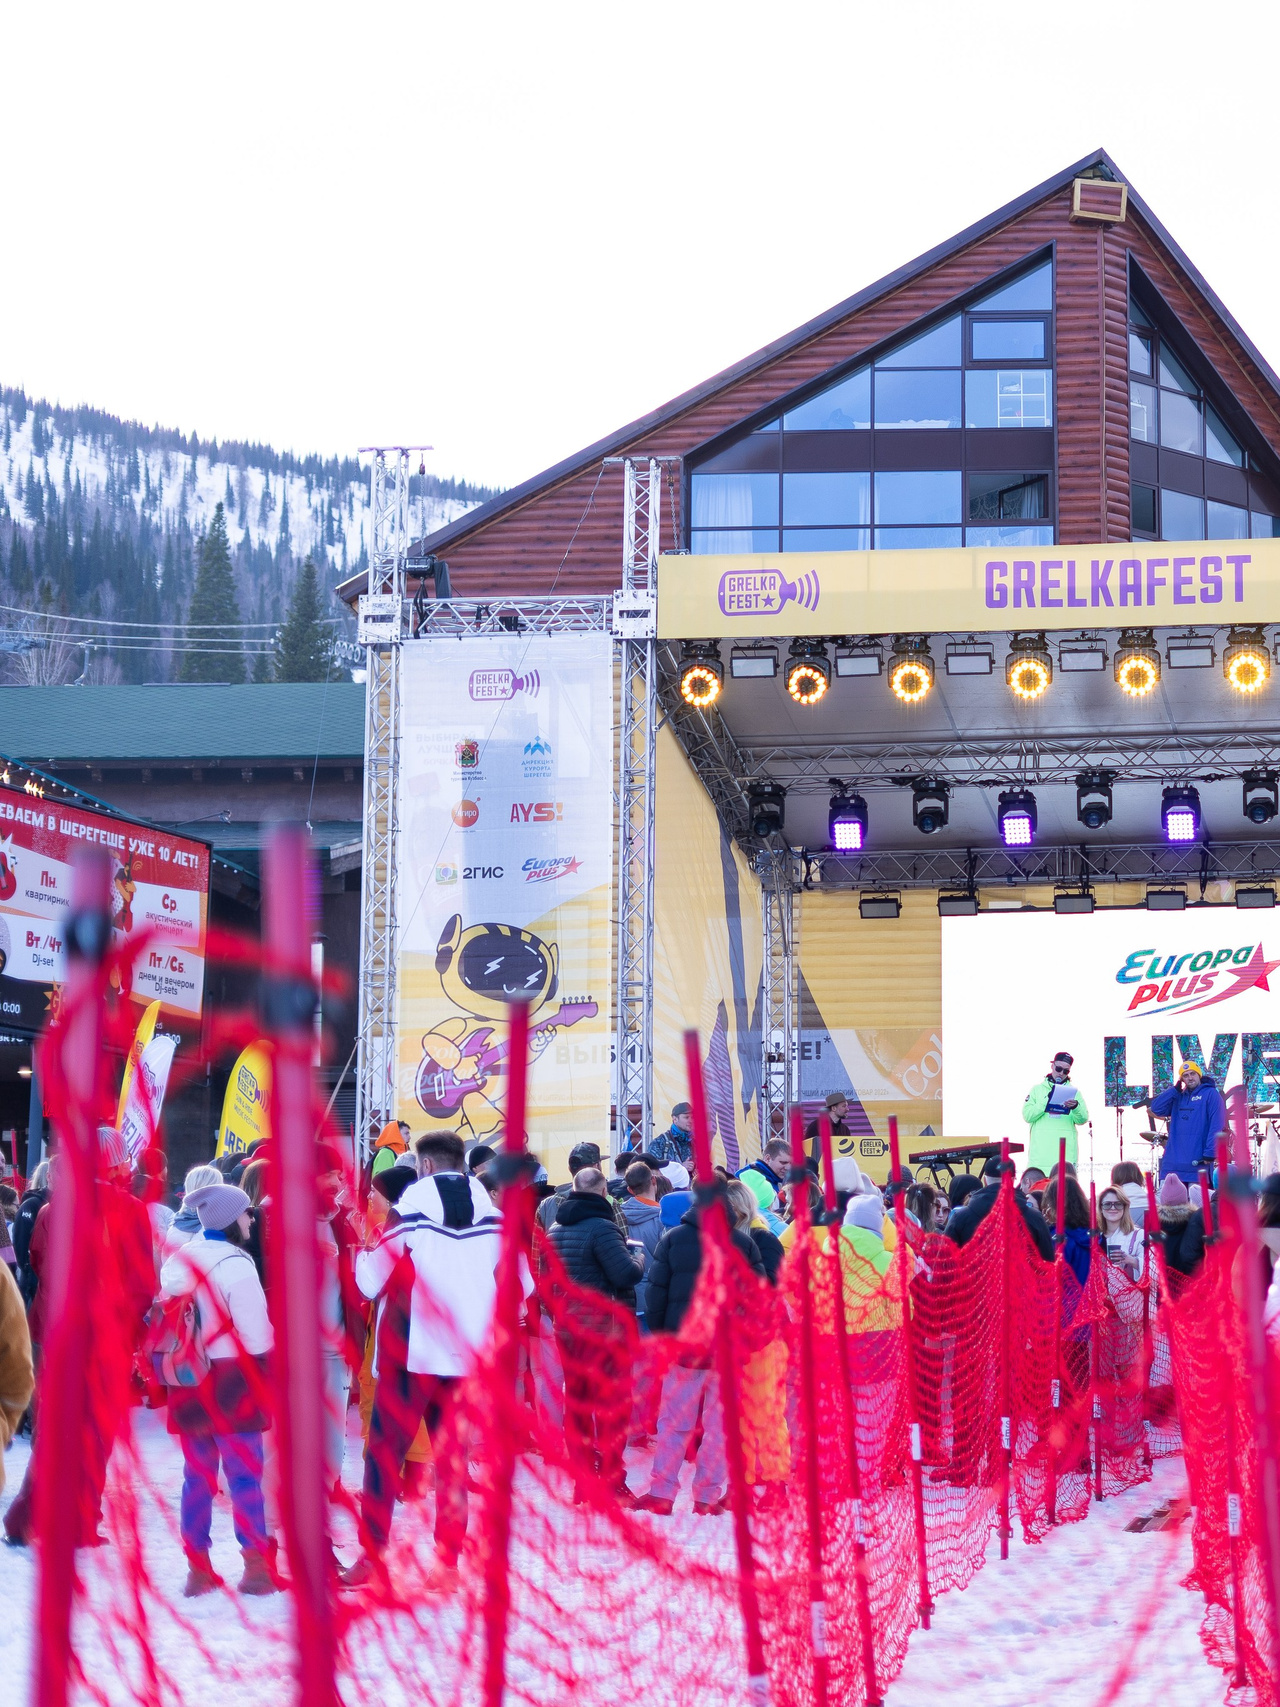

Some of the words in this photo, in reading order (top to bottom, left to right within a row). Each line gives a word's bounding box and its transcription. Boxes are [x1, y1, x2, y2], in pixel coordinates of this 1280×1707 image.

[728, 576, 776, 593] GRELKA
[985, 554, 1252, 609] GRELKAFEST
[728, 594, 761, 610] FEST
[475, 672, 510, 685] GRELKA
[475, 685, 499, 697] FEST
[510, 802, 563, 823] AYS!
[48, 816, 56, 831] В
[60, 819, 125, 850] ШЕРЕГЕШЕ
[129, 837, 155, 857] УЖЕ
[158, 846, 170, 863] 10
[173, 853, 199, 869] ЛЕТ!
[463, 866, 504, 879] 2ГИС
[521, 856, 572, 872] Europa
[40, 871, 57, 888] Пн.
[162, 893, 178, 914] Ср.
[145, 910, 193, 929] акустический
[155, 922, 183, 937] концерт
[32, 953, 54, 967] Dj-set
[1115, 944, 1255, 984] Europa
[138, 971, 157, 982] днем
[158, 975, 163, 983] и
[164, 976, 195, 990] вечером
[154, 982, 178, 995] Dj-sets
[902, 1033, 942, 1097] Col
[863, 1140, 882, 1148] GRELKA
[1229, 1498, 1237, 1532] SET
